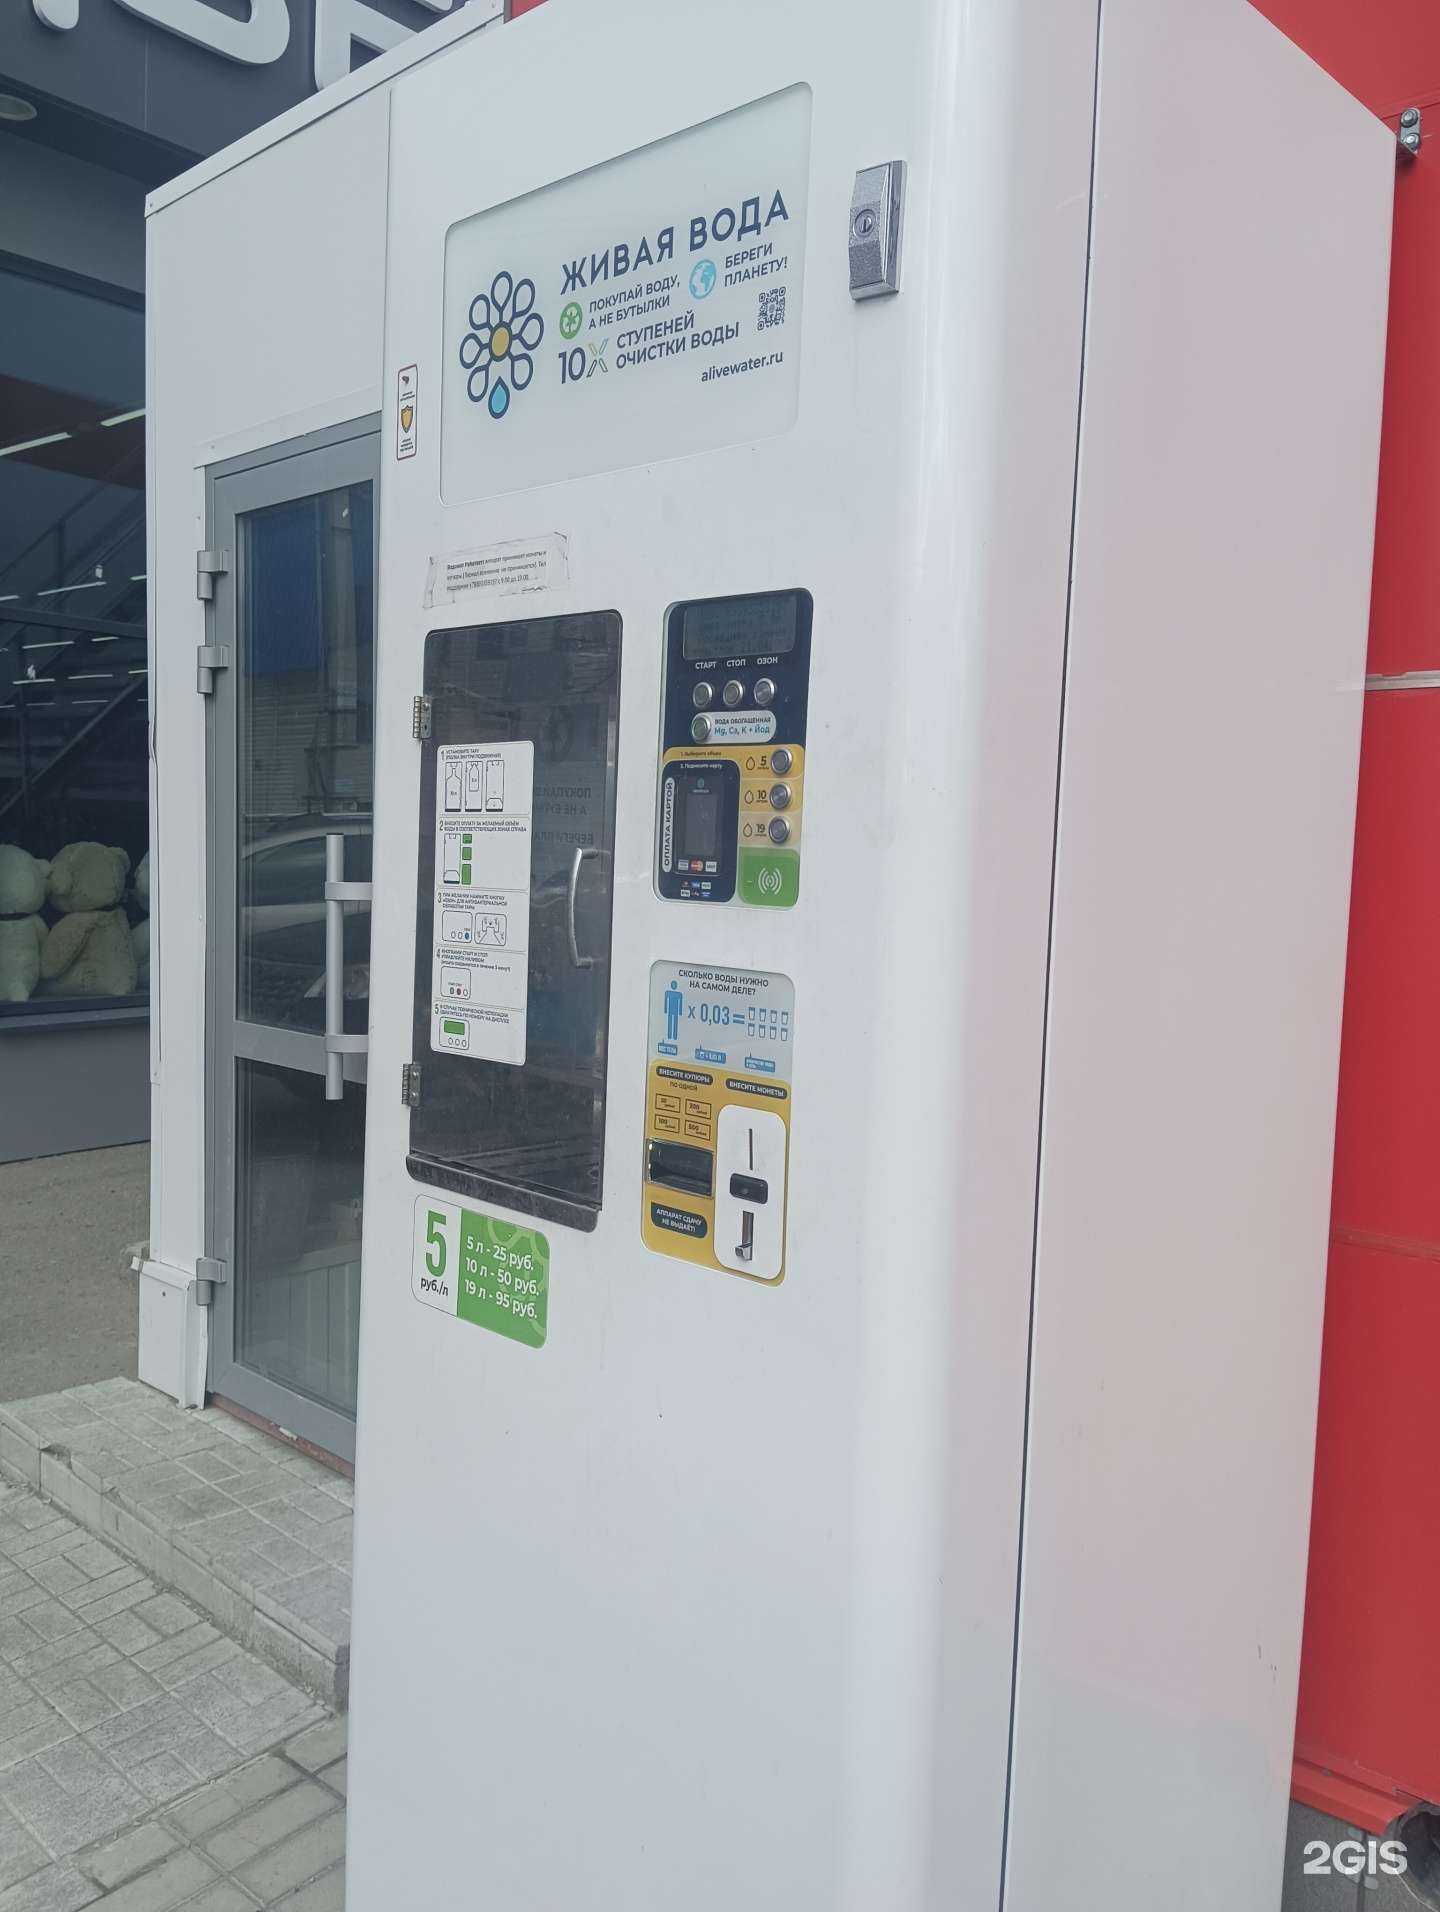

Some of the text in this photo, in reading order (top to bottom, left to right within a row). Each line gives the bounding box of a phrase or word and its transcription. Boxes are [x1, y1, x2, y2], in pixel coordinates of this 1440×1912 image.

[559, 188, 789, 295] ЖИВАЯ ВОДА
[725, 242, 773, 269] БЕРЕГИ
[723, 256, 788, 287] ПЛАНЕТУ!
[588, 274, 681, 314] ПОКУПАЙ ВОДУ,
[588, 295, 670, 331] А НЕ БУТЫЛКИ
[616, 311, 695, 349] СТУПЕНЕЙ
[616, 322, 740, 369] ОЧИСТКИ ВОДЫ
[700, 352, 784, 382] alivewater.ru
[695, 661, 717, 670] СТАРТ
[726, 658, 746, 667] СТОП
[757, 656, 778, 665] ОЗОН
[760, 756, 767, 766] 5
[757, 790, 767, 799] 10
[439, 820, 444, 831] 2
[664, 782, 673, 866] ОПЛАТА КАРТОЙ
[757, 823, 766, 833] 19
[437, 893, 442, 903] 3
[678, 969, 769, 987] СКОЛЬКО ВОДЫ НУЖНО
[689, 981, 756, 996] НА САМОМ ДЕЛЕ?
[434, 1003, 439, 1014] 5
[700, 1003, 730, 1026] 0,03
[659, 1068, 711, 1084] ВНЕСИТЕ КУПЮРЫ
[729, 1081, 784, 1097] ВНЕСИТЕ МОНЕТЫ
[656, 1208, 682, 1220] АППАРАТ
[662, 1218, 670, 1226] НЕ
[425, 1210, 447, 1278] 5
[466, 1236, 474, 1250] 5
[475, 1242, 484, 1253] л
[493, 1245, 507, 1262] 25
[509, 1252, 534, 1271] руб.
[466, 1257, 477, 1273] 10
[479, 1265, 488, 1277] л
[497, 1269, 512, 1286] 50
[514, 1277, 540, 1296] руб.
[420, 1277, 449, 1296] руб./л
[464, 1279, 476, 1295] 19
[478, 1288, 486, 1299] л
[496, 1291, 510, 1308] 95
[512, 1299, 538, 1319] руб.
